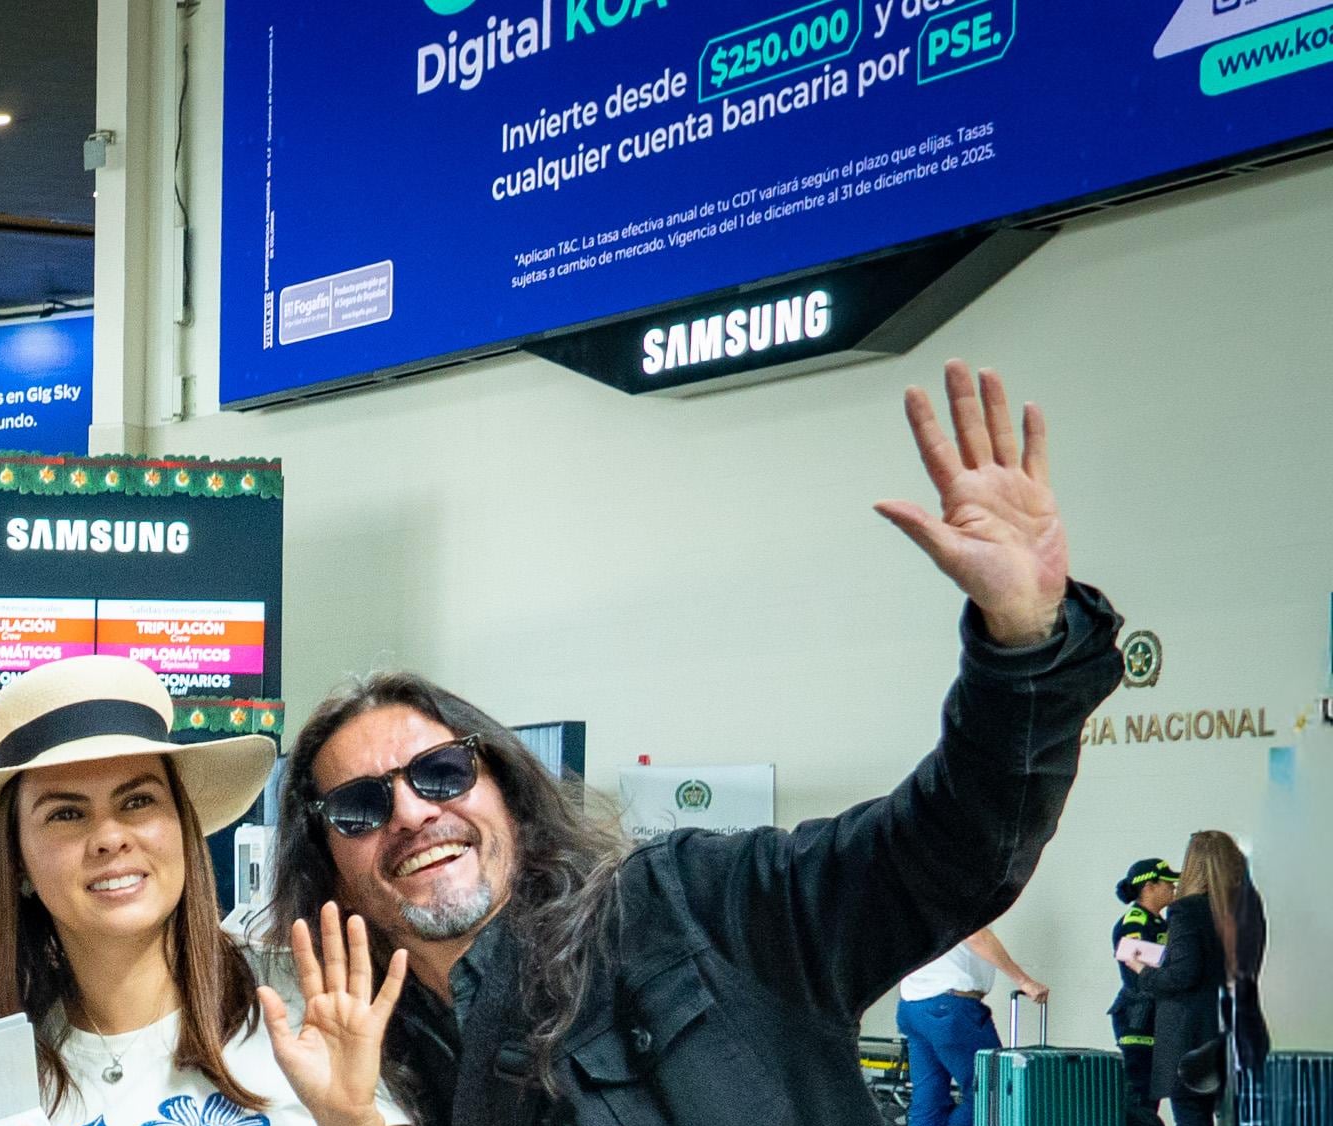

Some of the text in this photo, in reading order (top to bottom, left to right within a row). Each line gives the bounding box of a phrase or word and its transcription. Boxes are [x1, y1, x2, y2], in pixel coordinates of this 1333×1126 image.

[417, 0, 551, 94] Digital
[501, 101, 598, 153] Invierte
[604, 68, 687, 119] desde
[710, 8, 849, 88] $250.000
[874, 0, 893, 38] y
[491, 12, 1002, 201] cualquier cuenta bancaria por PSE.
[511, 143, 996, 289] sujetas a cambio de mercado. Vigencia del 1 de diciembre al 31 de diciembre de 2025.
[583, 236, 595, 250] La
[597, 228, 619, 245] tasa
[621, 216, 664, 239] efectiva
[666, 206, 697, 226] anual
[699, 202, 715, 218] de
[717, 199, 730, 212] tu
[732, 188, 758, 207] CDT
[759, 176, 799, 200] variará
[801, 167, 839, 191] según
[841, 160, 853, 178] el
[856, 153, 889, 177] plazo
[891, 144, 916, 164] que
[919, 134, 954, 155] elijas.
[957, 122, 994, 143] Tasas
[642, 290, 832, 375] SAMSUNG
[6, 390, 23, 404] en
[54, 383, 81, 402] Sky
[6, 517, 190, 554] SAMSUNG
[1, 632, 21, 641] Crew
[129, 645, 231, 662] DIPLOMÁTICOS
[136, 620, 225, 635] TRIPULACIÓN
[1125, 707, 1275, 743] NACIONAL
